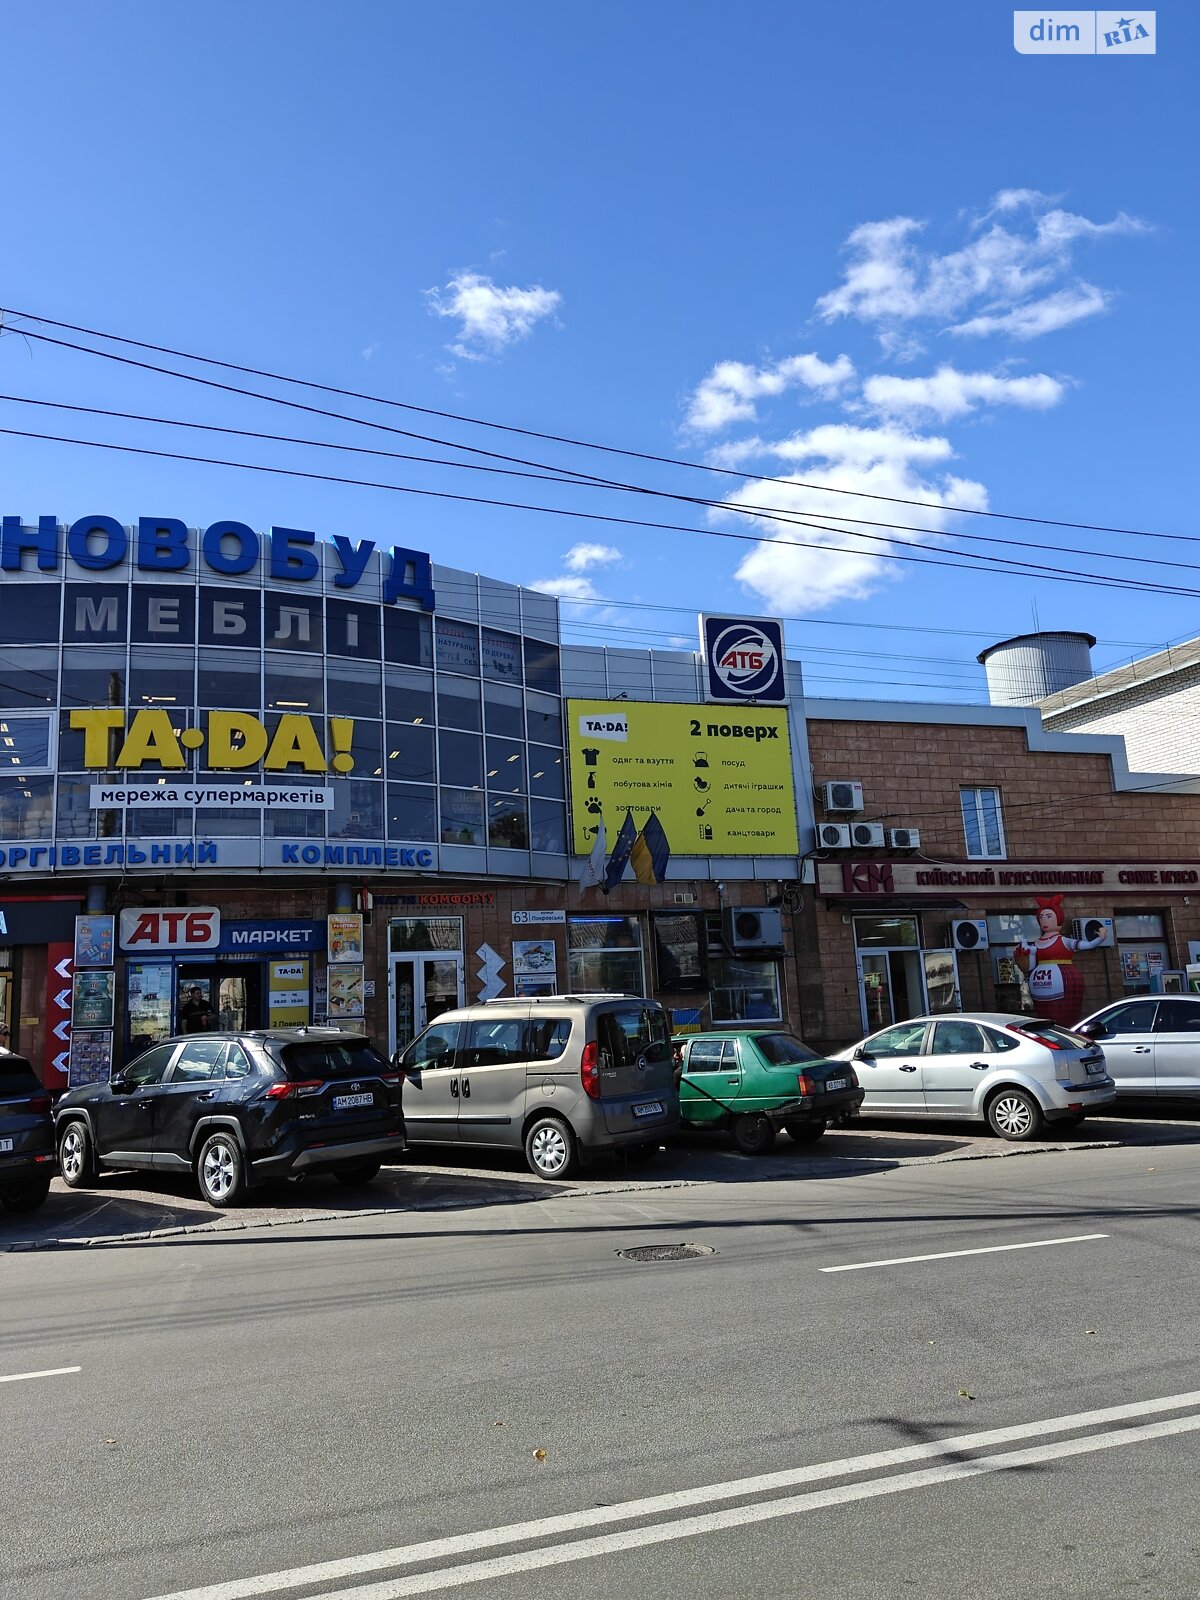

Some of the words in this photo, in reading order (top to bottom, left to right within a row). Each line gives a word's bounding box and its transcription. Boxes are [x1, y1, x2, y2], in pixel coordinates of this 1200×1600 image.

[1, 514, 435, 611] НОВОБУД
[75, 596, 359, 647] МЕБЛІ
[721, 650, 764, 669] АТБ
[690, 719, 701, 736] 2
[707, 724, 778, 742] поверх
[613, 780, 651, 788] побутова
[723, 782, 750, 790] дитячі
[751, 783, 784, 791] іграшки
[100, 787, 178, 804] мережа
[184, 787, 325, 806] супермаркетів
[757, 807, 781, 815] город
[727, 830, 775, 838] канцтовари
[0, 840, 218, 868] РГІВЕЛЬНИЙ
[282, 844, 433, 867] КОМПЛЕКС
[916, 867, 996, 886] КИЇВСЬКИЙ
[1118, 870, 1158, 884] СВІЖЕ
[419, 894, 495, 905] КОМФОРТУ
[513, 911, 529, 923] 63
[127, 913, 214, 944] АТБ
[232, 930, 312, 944] МАРКЕТ
